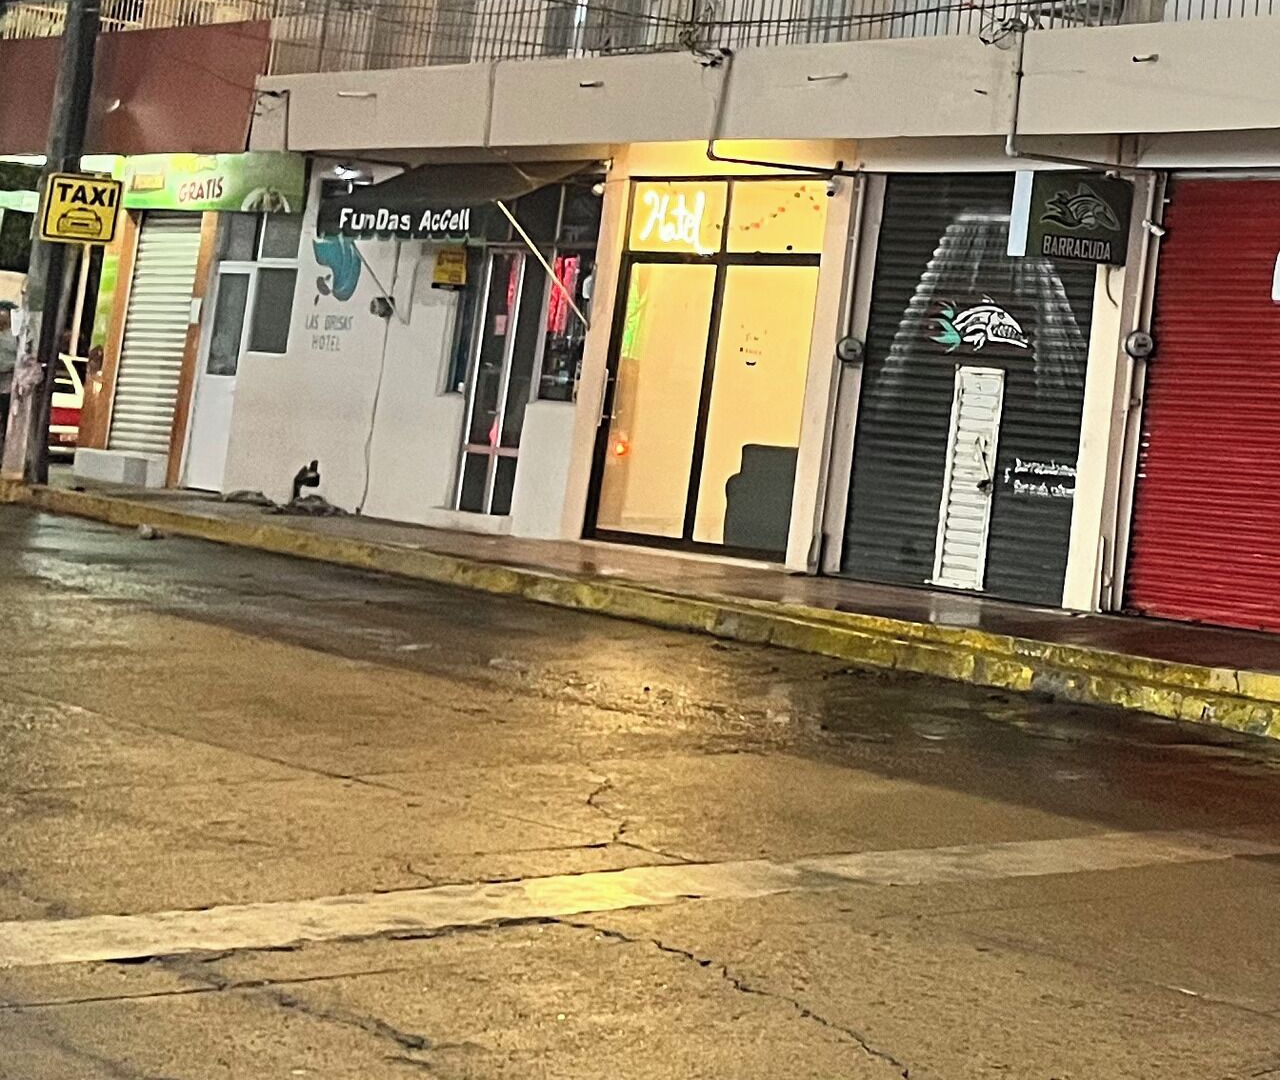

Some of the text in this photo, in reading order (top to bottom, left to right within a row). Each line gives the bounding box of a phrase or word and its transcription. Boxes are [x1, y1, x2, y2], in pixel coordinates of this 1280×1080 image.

[57, 182, 116, 208] TAXI
[179, 176, 224, 202] GRATIS
[640, 190, 714, 256] Hotel
[1042, 235, 1111, 261] BARRACUDA
[312, 335, 341, 351] HOTEL
